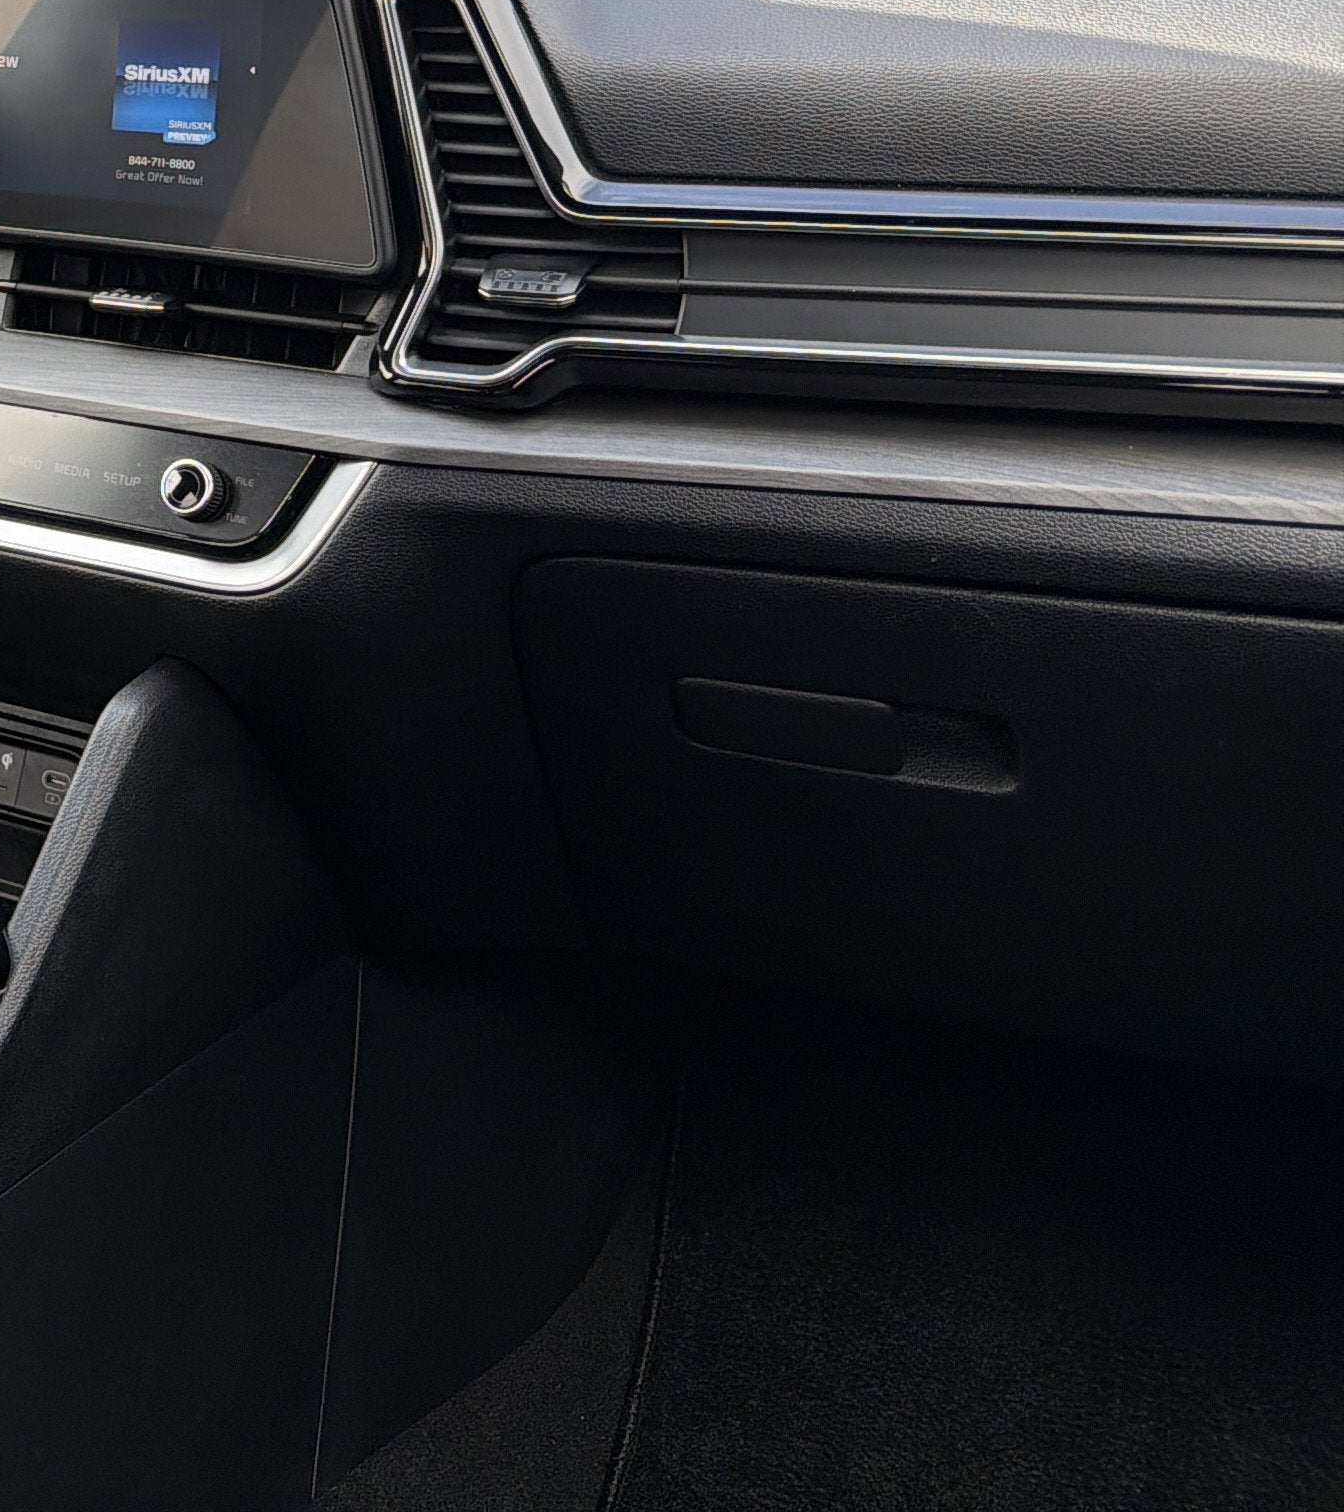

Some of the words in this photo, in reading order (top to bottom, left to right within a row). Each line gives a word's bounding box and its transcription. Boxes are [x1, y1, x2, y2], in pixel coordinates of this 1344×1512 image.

[124, 64, 210, 84] SiriusXM
[167, 119, 213, 131] SIRIUSXM
[128, 155, 196, 170] 844-711-8800
[115, 169, 145, 182] Great
[147, 171, 175, 184] Offer
[177, 173, 204, 186] Now!
[7, 454, 43, 471] RADIO
[53, 462, 91, 479] MEDIA
[102, 472, 142, 487] SETUP
[234, 475, 255, 488] FILE
[224, 512, 249, 525] TUNE
